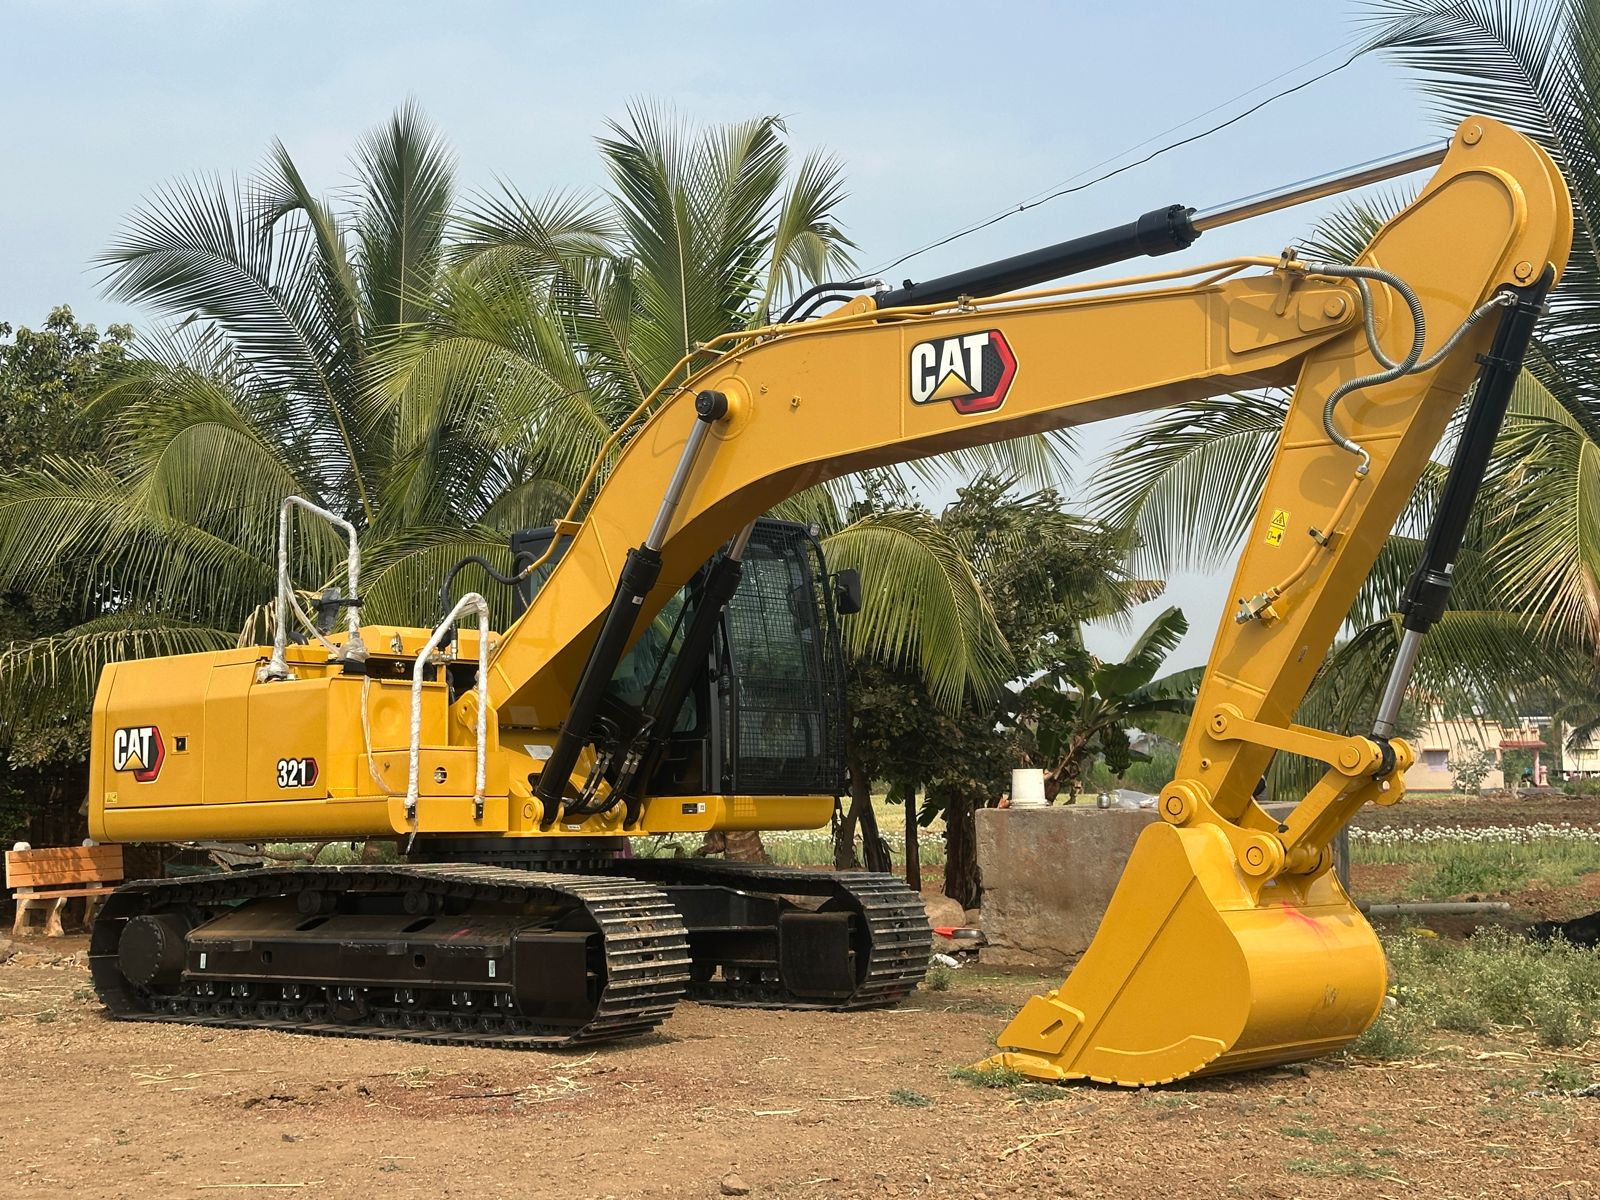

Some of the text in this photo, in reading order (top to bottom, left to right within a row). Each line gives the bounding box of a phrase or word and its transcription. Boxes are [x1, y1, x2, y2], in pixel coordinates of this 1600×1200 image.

[911, 332, 989, 403] CAT
[114, 727, 153, 771] CAT
[277, 759, 306, 787] 321
